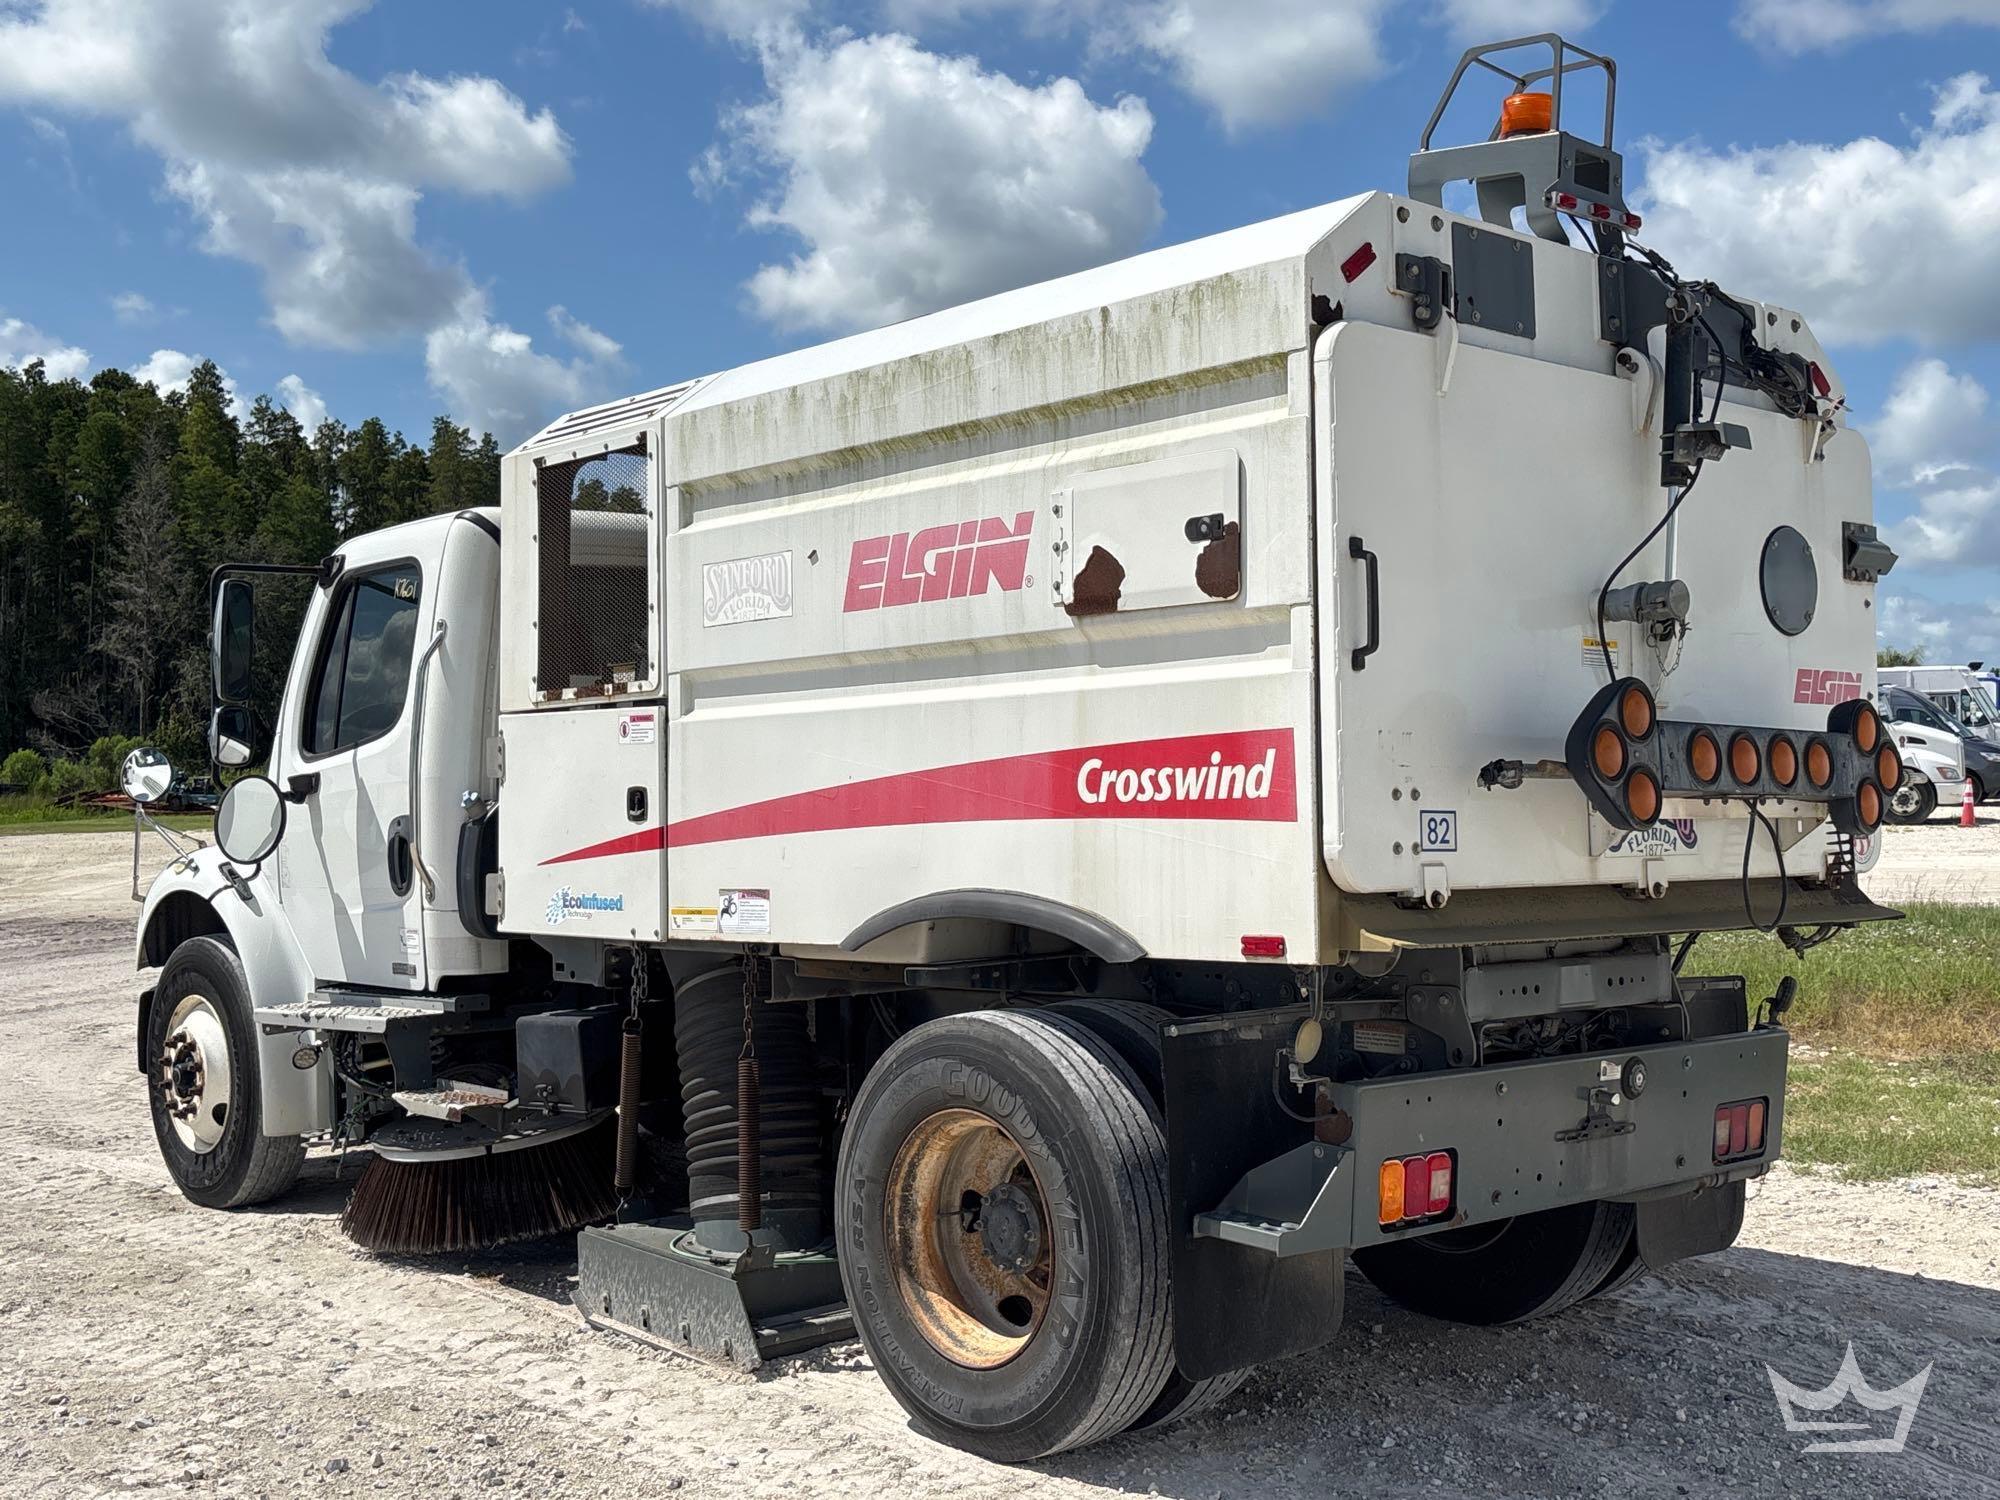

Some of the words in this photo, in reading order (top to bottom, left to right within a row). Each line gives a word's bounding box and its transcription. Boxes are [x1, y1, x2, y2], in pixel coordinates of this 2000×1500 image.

[843, 510, 1035, 613] ELGIN
[704, 554, 791, 621] SANFORD
[723, 595, 771, 620] FLORIDA
[1793, 668, 1862, 705] ELGIN
[1077, 748, 1276, 804] Crosswind
[1427, 817, 1450, 845] 82
[1627, 827, 1678, 853] FLORIDA
[1644, 843, 1664, 857] 1877
